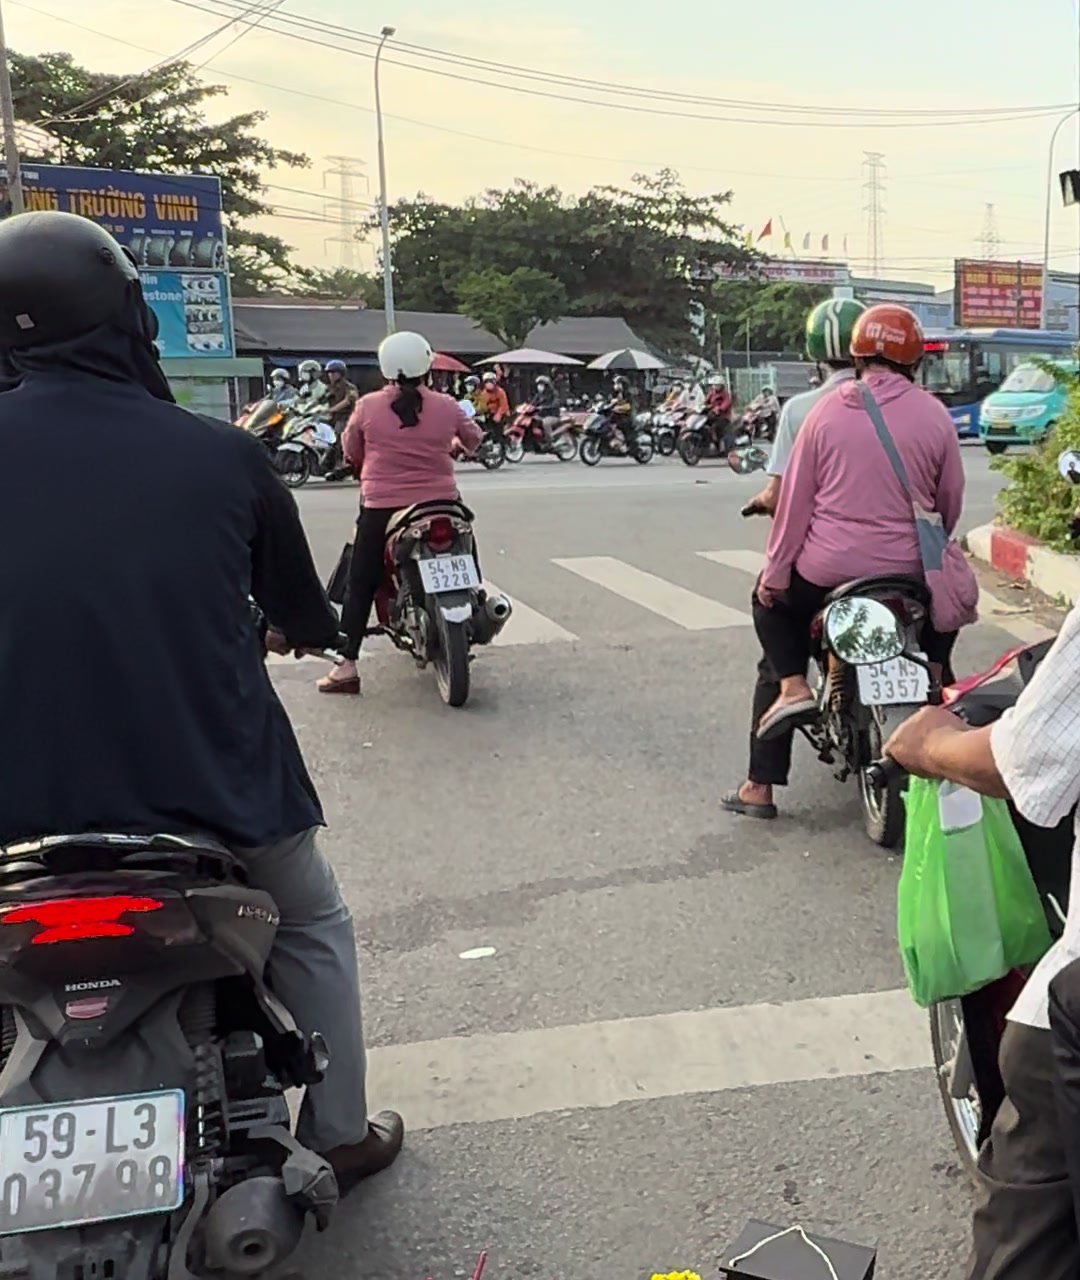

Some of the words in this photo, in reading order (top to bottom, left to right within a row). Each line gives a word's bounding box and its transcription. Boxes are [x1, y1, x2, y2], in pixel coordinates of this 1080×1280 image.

[66, 185, 147, 219] TRƯỜNG
[153, 193, 199, 222] VINH
[432, 573, 471, 589] 3228
[871, 679, 919, 700] 3357
[65, 979, 121, 991] HONDA
[23, 1103, 157, 1163] 59-L3
